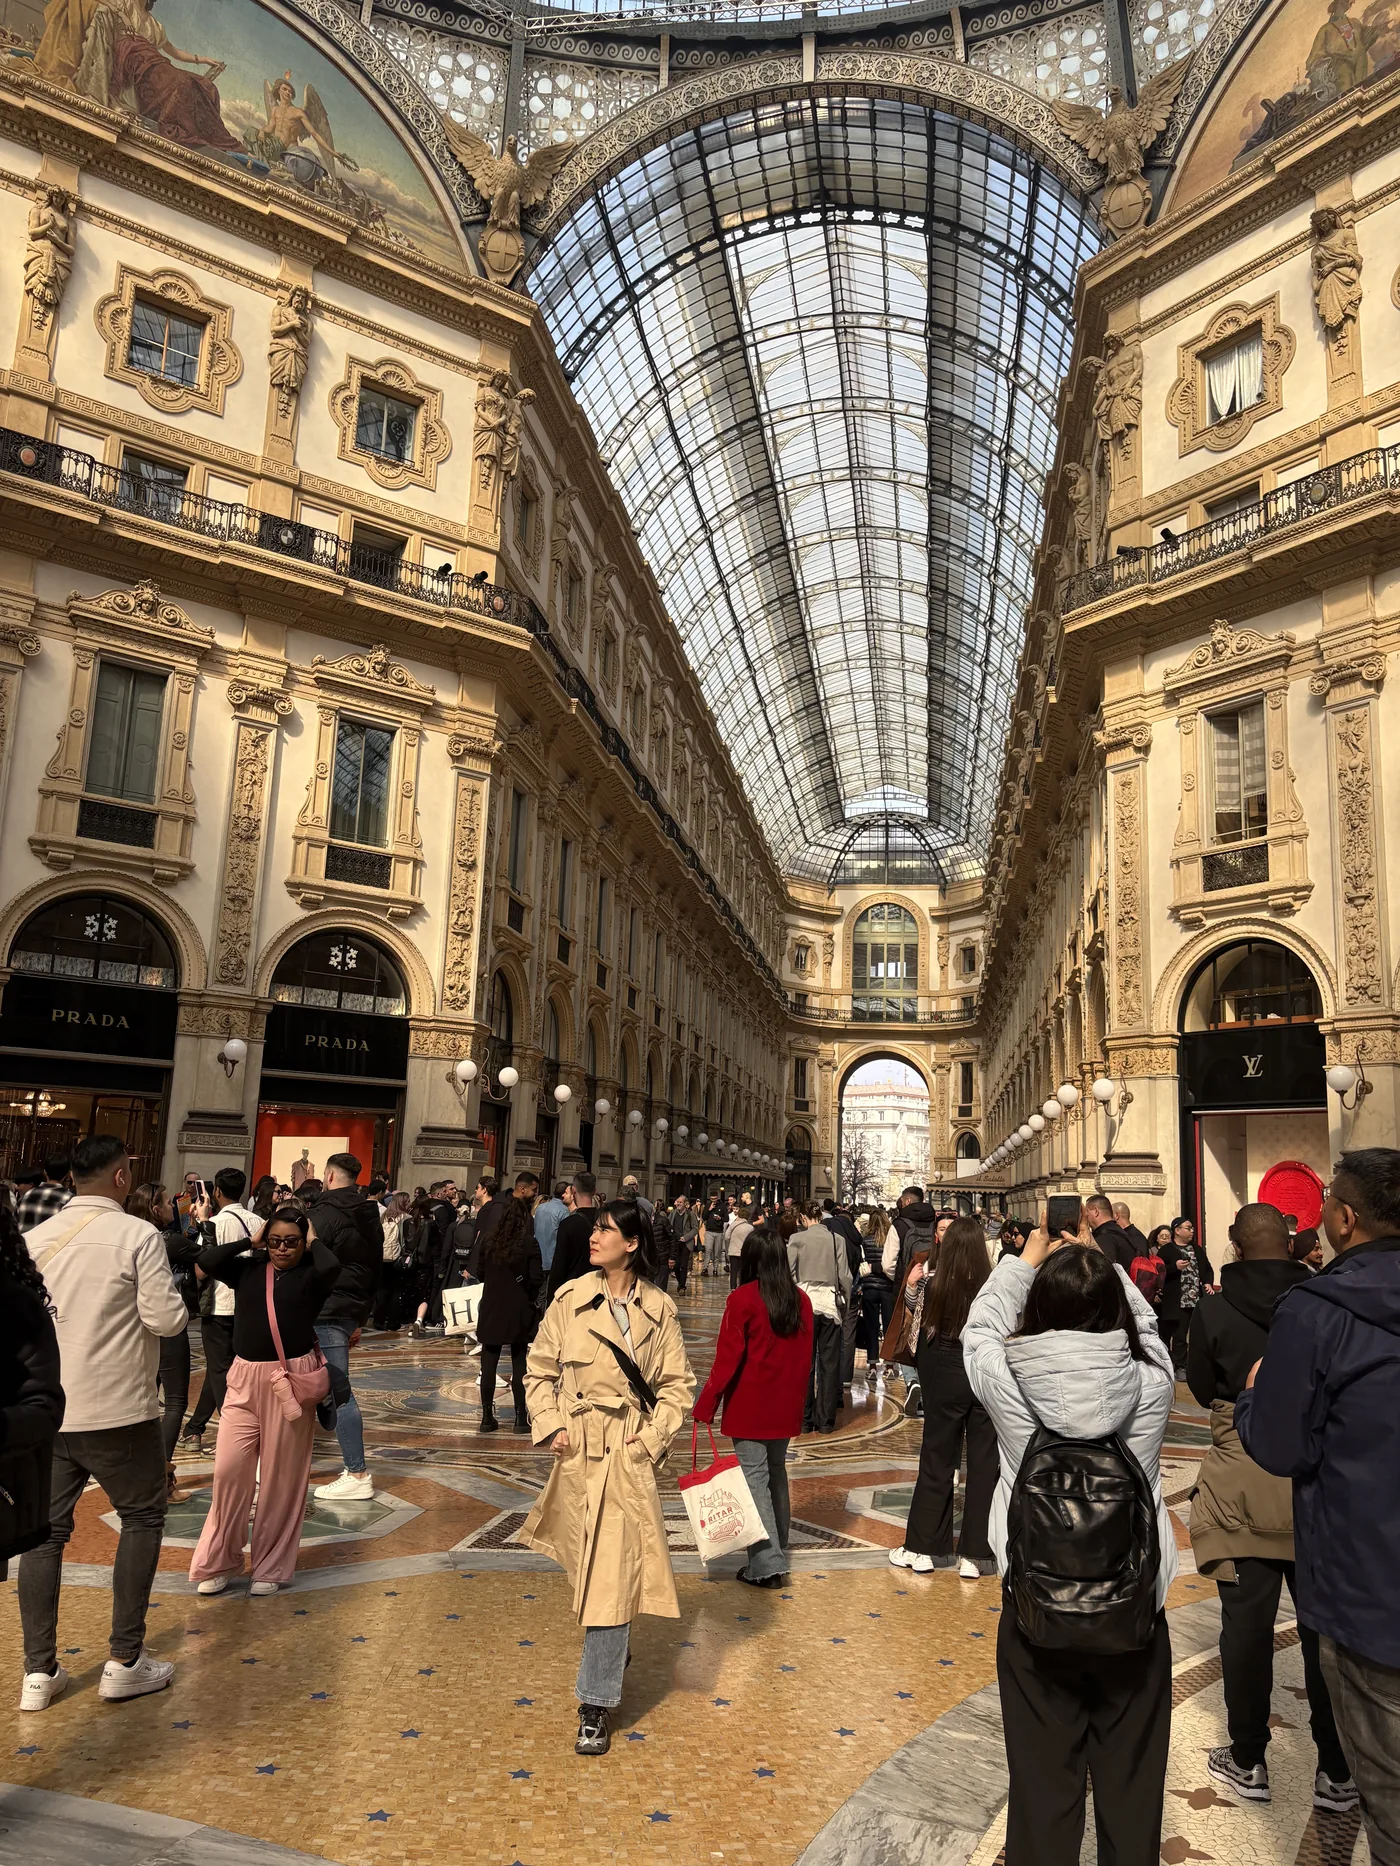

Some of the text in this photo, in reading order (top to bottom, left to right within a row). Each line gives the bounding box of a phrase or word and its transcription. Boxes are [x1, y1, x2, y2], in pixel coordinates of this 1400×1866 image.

[51, 1008, 130, 1029] PRADA
[304, 1034, 370, 1052] PRADA
[448, 1298, 475, 1327] H
